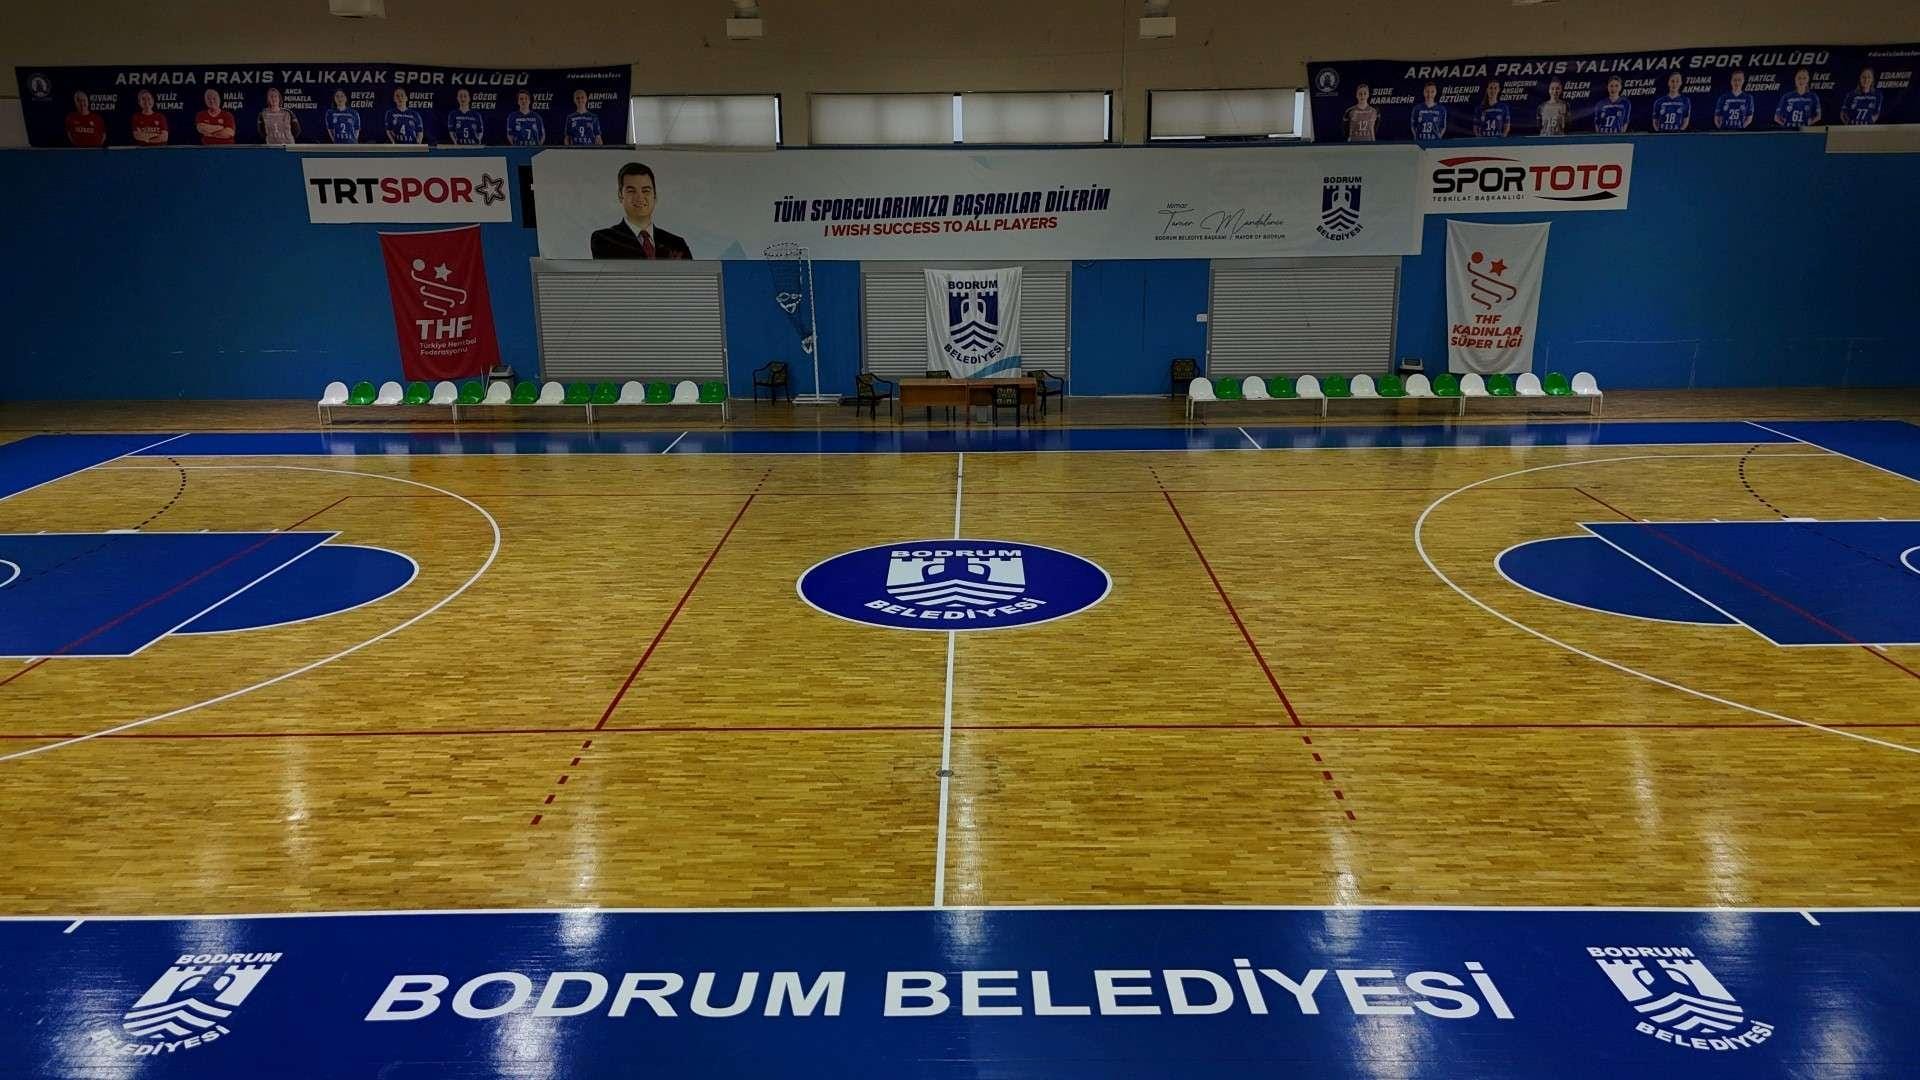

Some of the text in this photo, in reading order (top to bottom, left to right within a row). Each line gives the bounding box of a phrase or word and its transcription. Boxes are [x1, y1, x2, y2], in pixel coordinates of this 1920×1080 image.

[1404, 50, 1830, 79] ARMADA PRAXIS YALIKAVAK SPOR KULÜBÜ
[115, 70, 529, 86] ARMADA PRAXIS YALIKAVAK SPOR KULÜBÜ
[1624, 78, 1656, 88] CEYLAN
[351, 91, 375, 99] BEYZA
[409, 92, 434, 100] BUKET
[1372, 87, 1394, 95] SUDE
[1621, 87, 1656, 97] AYDEMİR
[408, 101, 433, 109] SEVEN
[1370, 95, 1415, 104] KARADEMİR
[156, 102, 184, 110] YILMAZ
[222, 101, 243, 110] AKÇA
[471, 101, 496, 110] SEVEN
[1856, 109, 1868, 120] 77
[1422, 121, 1433, 133] 13
[1485, 119, 1496, 131] 14
[1605, 116, 1616, 128] 17
[399, 124, 406, 135] 4
[463, 127, 469, 138] 5
[525, 129, 531, 140] 7
[578, 126, 585, 137] 9
[773, 184, 1111, 222] TÜM SPORCULARIMIZA BAŞARILAR DİLERİM
[824, 217, 1058, 237] I WISH SUCCESS TO ALL PLAYERS
[1316, 223, 1364, 241] BELEDİYESİ
[948, 280, 998, 290] BODRUM
[1475, 314, 1502, 324] THF
[415, 315, 473, 340] THF
[1452, 324, 1522, 337] KADINLAR
[419, 337, 477, 350] Türkiye Hentbol
[1450, 334, 1523, 348] SÜPER LİGİ
[420, 347, 468, 356] Federasyonu
[944, 340, 1006, 364] BELEDİYESİ
[890, 549, 1022, 557] BODRUM
[863, 597, 1048, 620] BELEDİYESİ
[1585, 946, 1695, 957] BODRUM
[174, 952, 283, 965] BODRUM
[364, 958, 1515, 1022] BODRUM BELEDİYESİ
[1635, 1019, 1775, 1051] BELEDİYESİ
